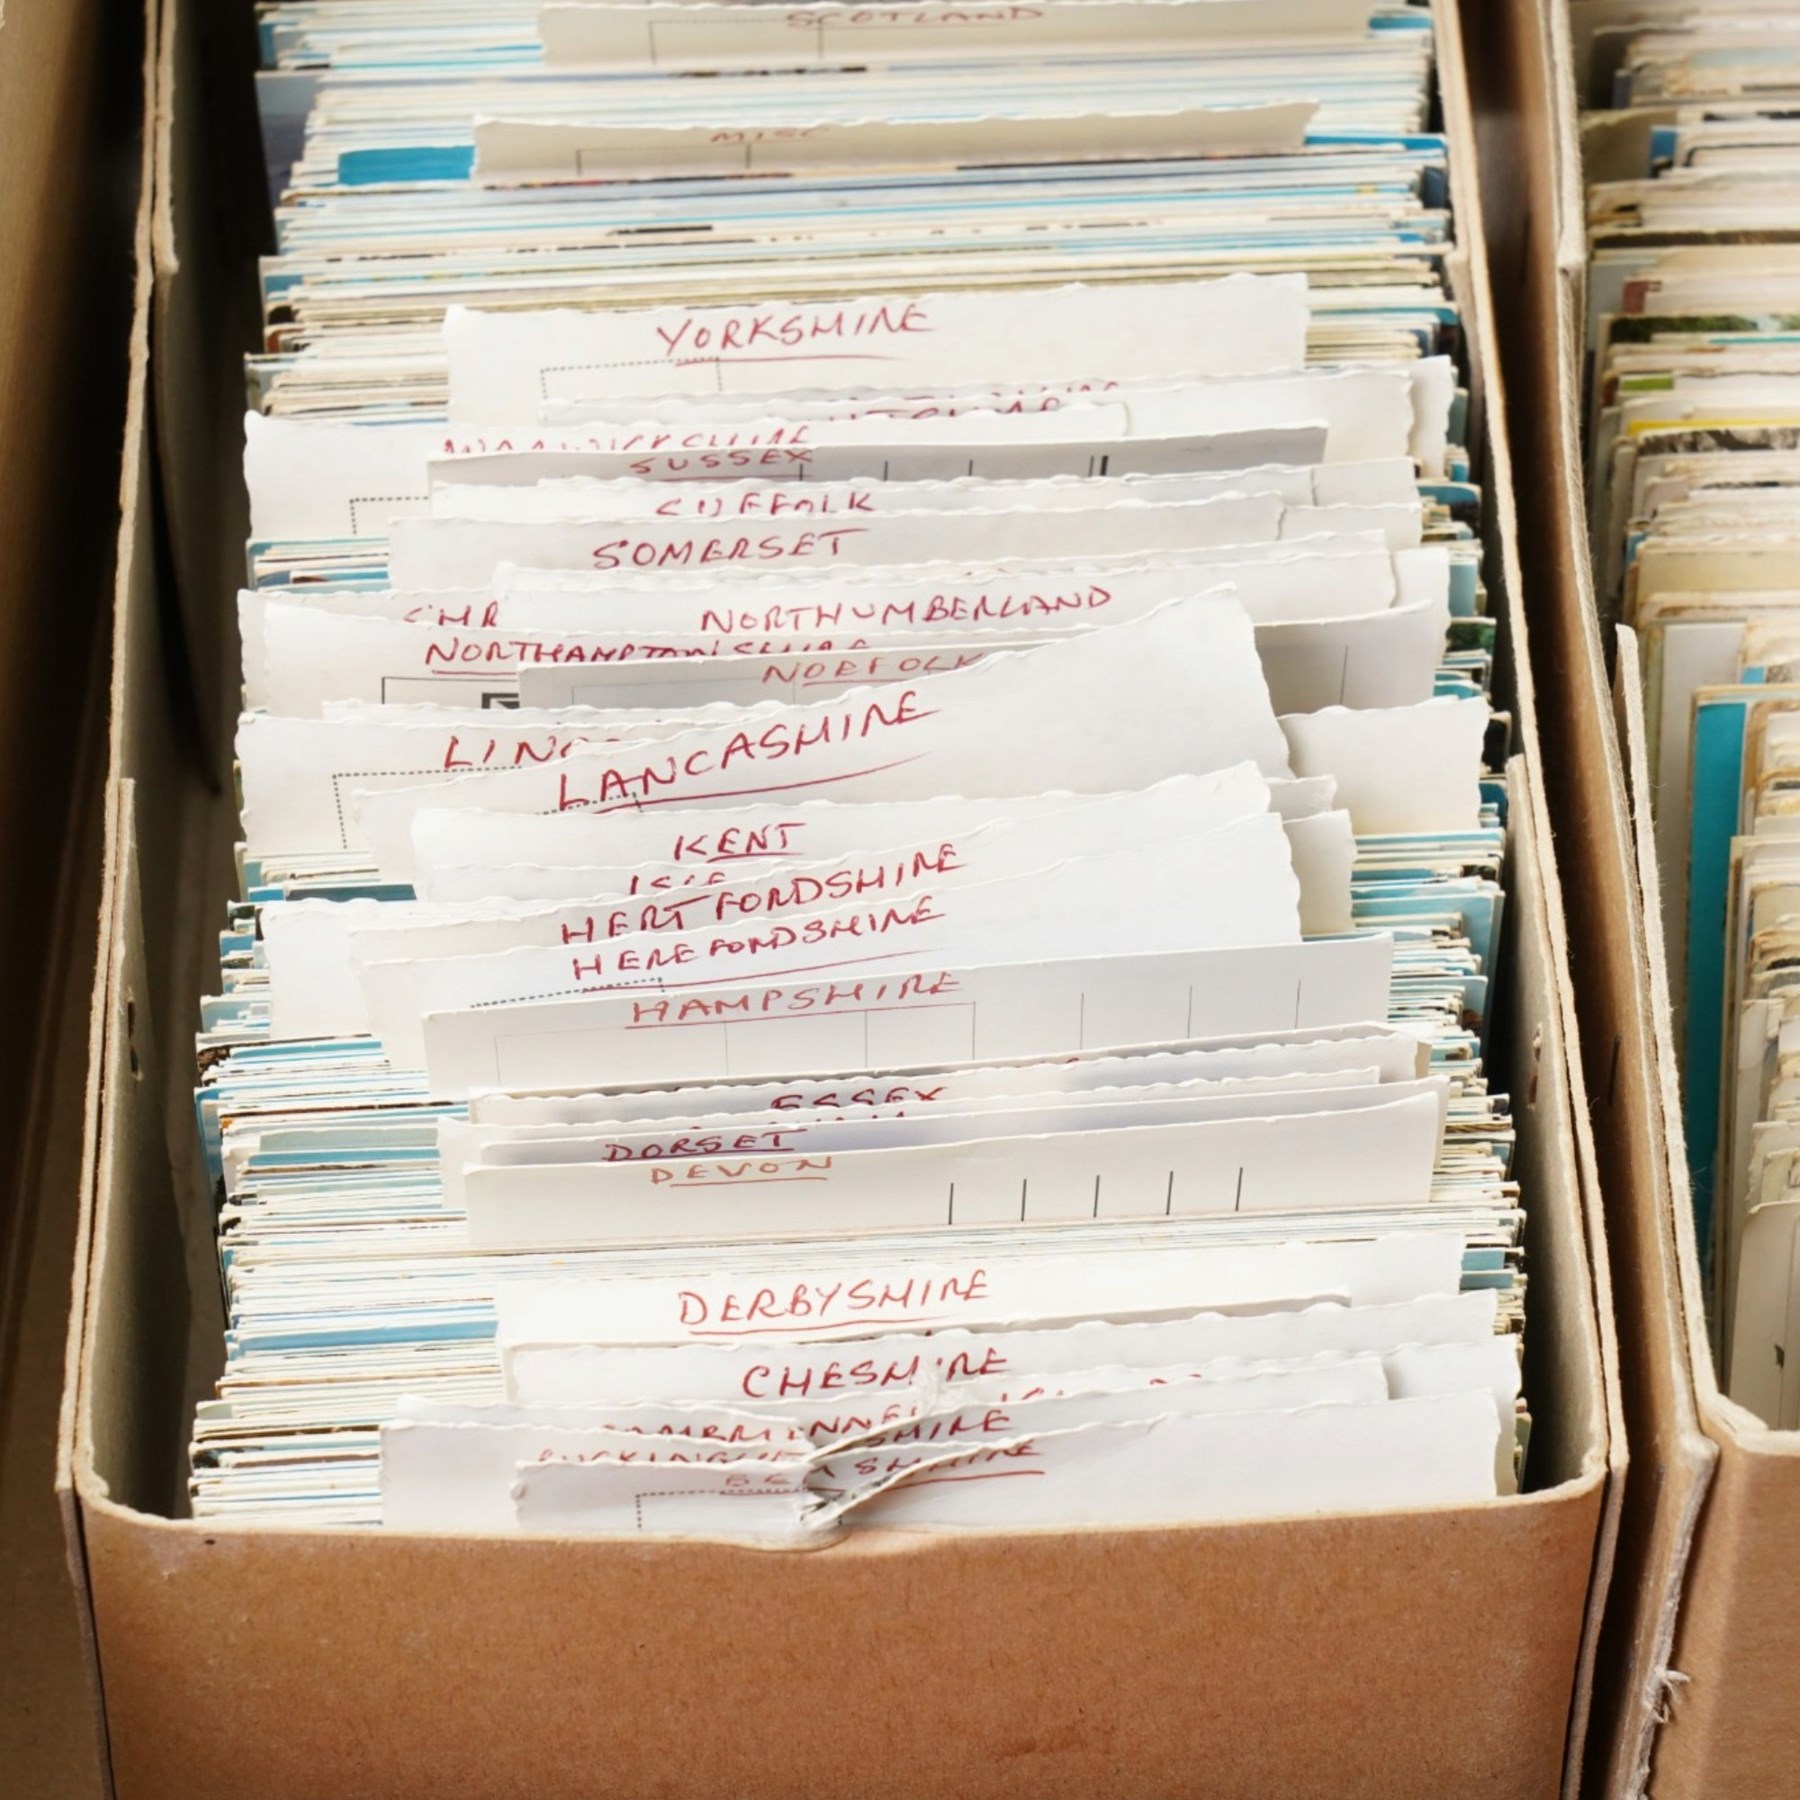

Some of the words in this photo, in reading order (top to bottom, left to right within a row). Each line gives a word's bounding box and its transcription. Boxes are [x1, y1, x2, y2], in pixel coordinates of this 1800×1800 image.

[656, 302, 937, 357] YORKSHIRE
[630, 449, 814, 475] SUSSEX
[593, 527, 871, 571] SOMERSET
[700, 584, 1112, 634] NORTHUMBERLAND
[762, 652, 985, 683] NORFOLK
[558, 690, 943, 811] LANCASHIRE
[674, 822, 807, 861] KENT
[561, 843, 968, 945] HERTFORDSHIRE
[572, 895, 947, 980] HEREFORDSHIRE
[632, 970, 964, 1024] HAMPSHIRE
[603, 1128, 808, 1163] DORSET
[650, 1155, 832, 1185] DEVON
[679, 1268, 989, 1327] DERBYSHIRE
